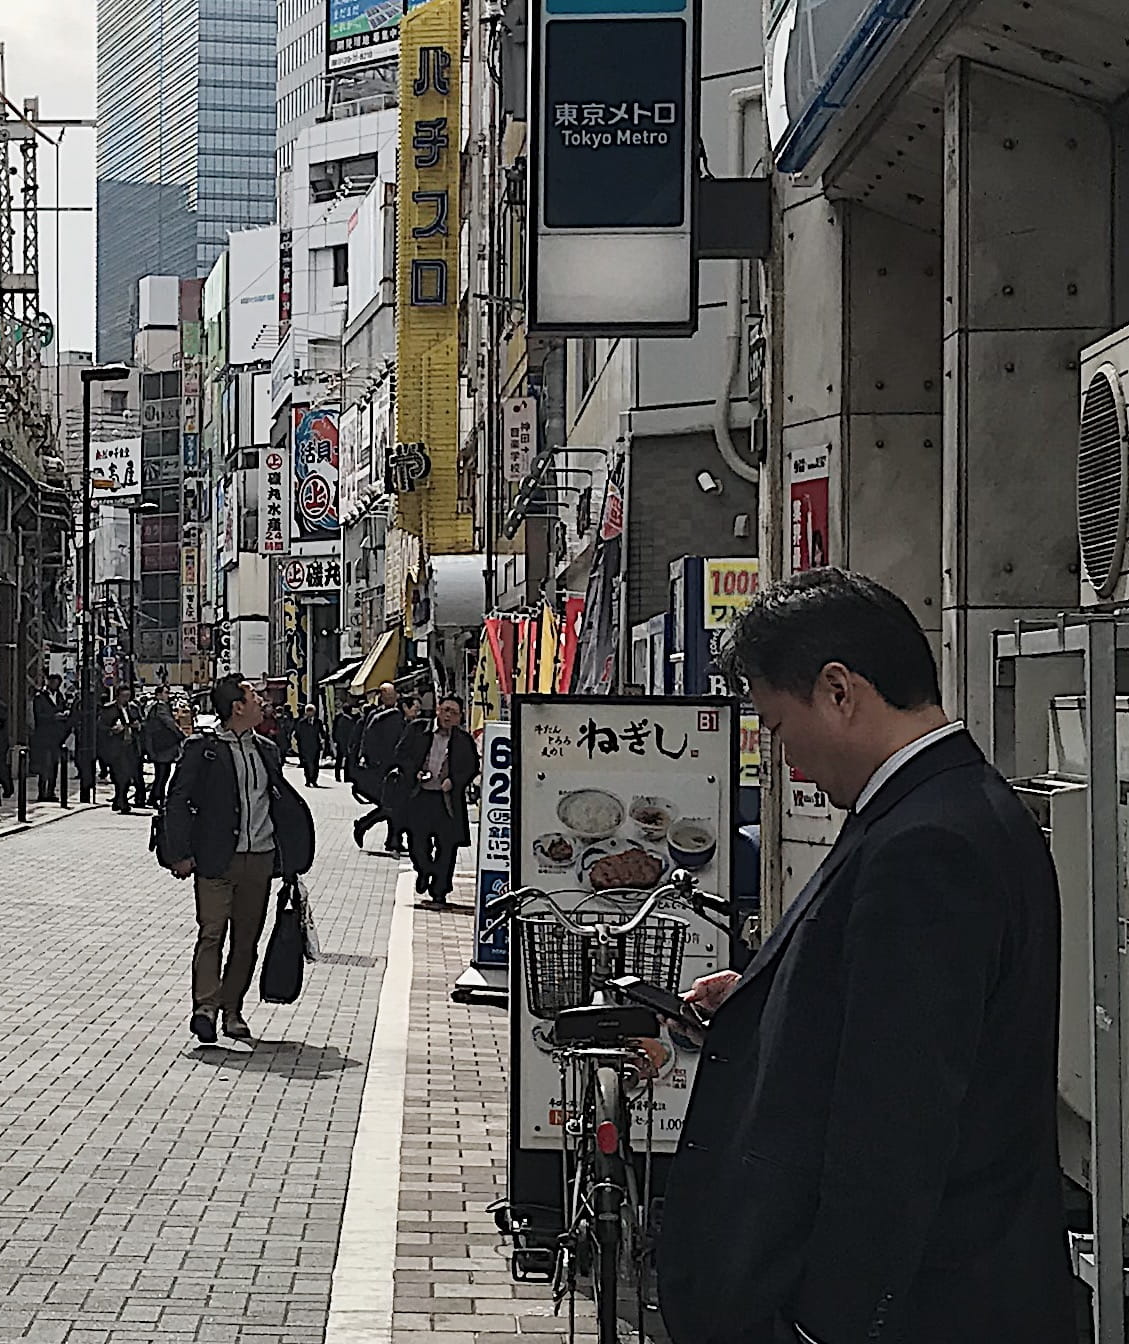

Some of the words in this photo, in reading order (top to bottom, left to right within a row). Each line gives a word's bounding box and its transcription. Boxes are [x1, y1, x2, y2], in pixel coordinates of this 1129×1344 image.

[554, 101, 676, 126] 東京メトロ
[561, 129, 612, 148] Tokyo
[616, 129, 668, 146] Metro
[410, 45, 452, 308] パチスロ
[699, 712, 718, 731] B1
[577, 717, 688, 760] ねぎし
